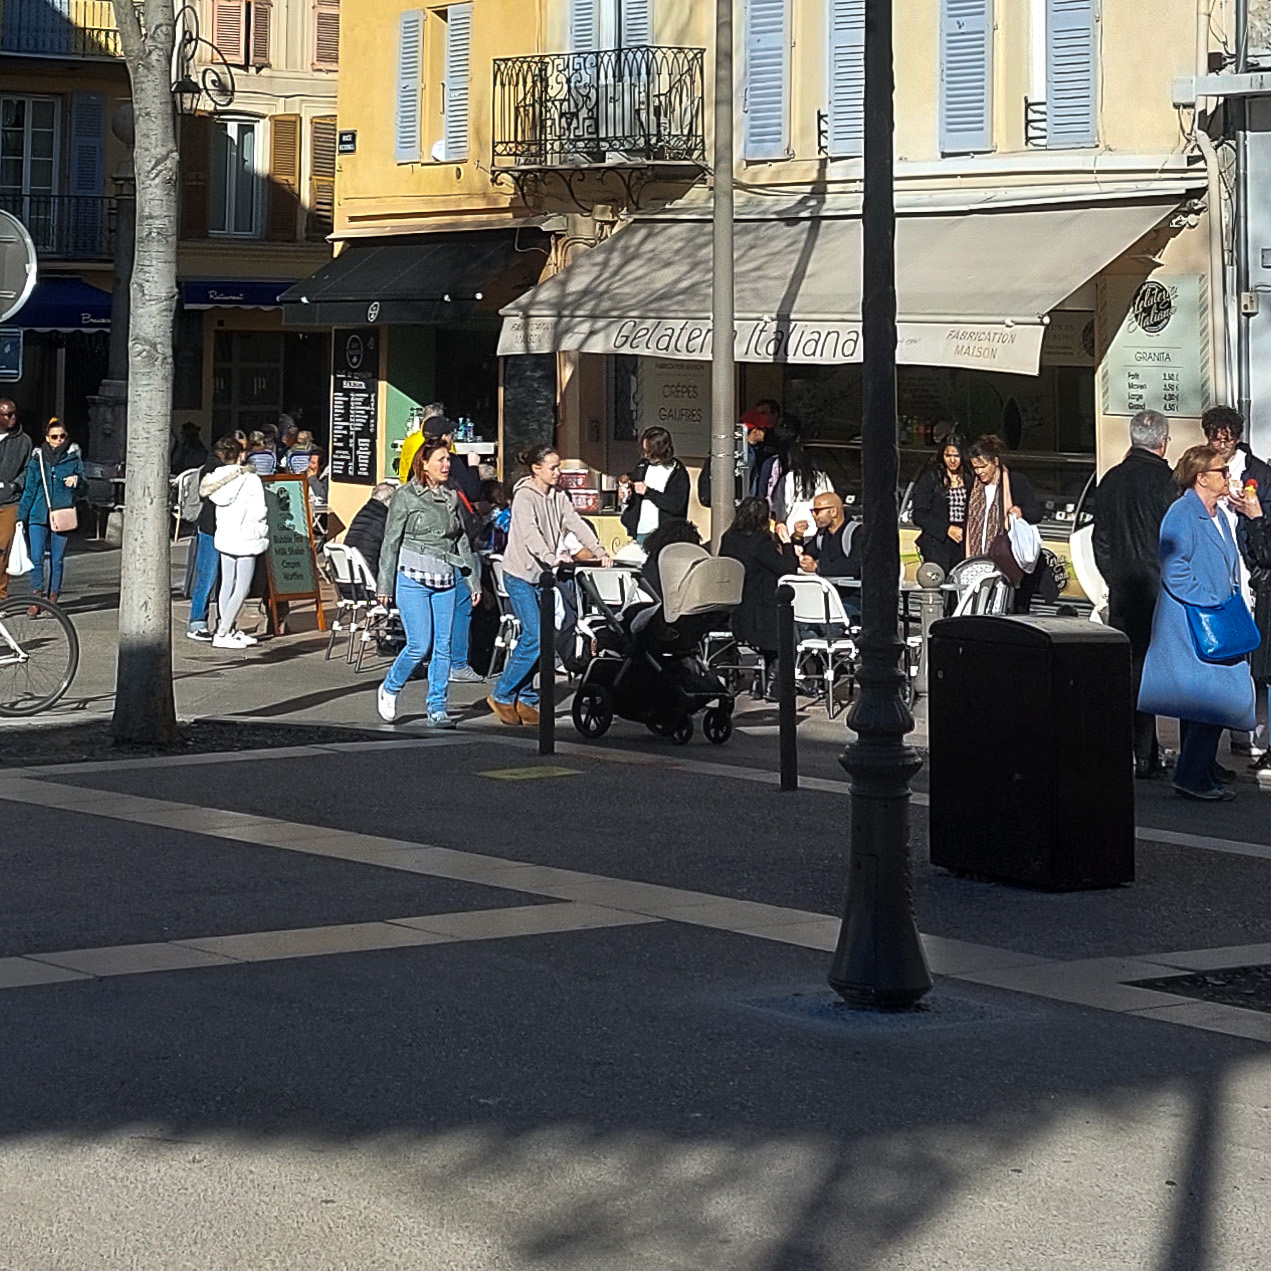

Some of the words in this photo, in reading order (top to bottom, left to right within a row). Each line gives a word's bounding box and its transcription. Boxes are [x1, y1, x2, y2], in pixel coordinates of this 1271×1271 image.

[744, 323, 863, 359] Italiana
[946, 330, 1016, 345] FABRICATION
[954, 344, 998, 360] MAISON
[1134, 351, 1171, 362] GRANITA
